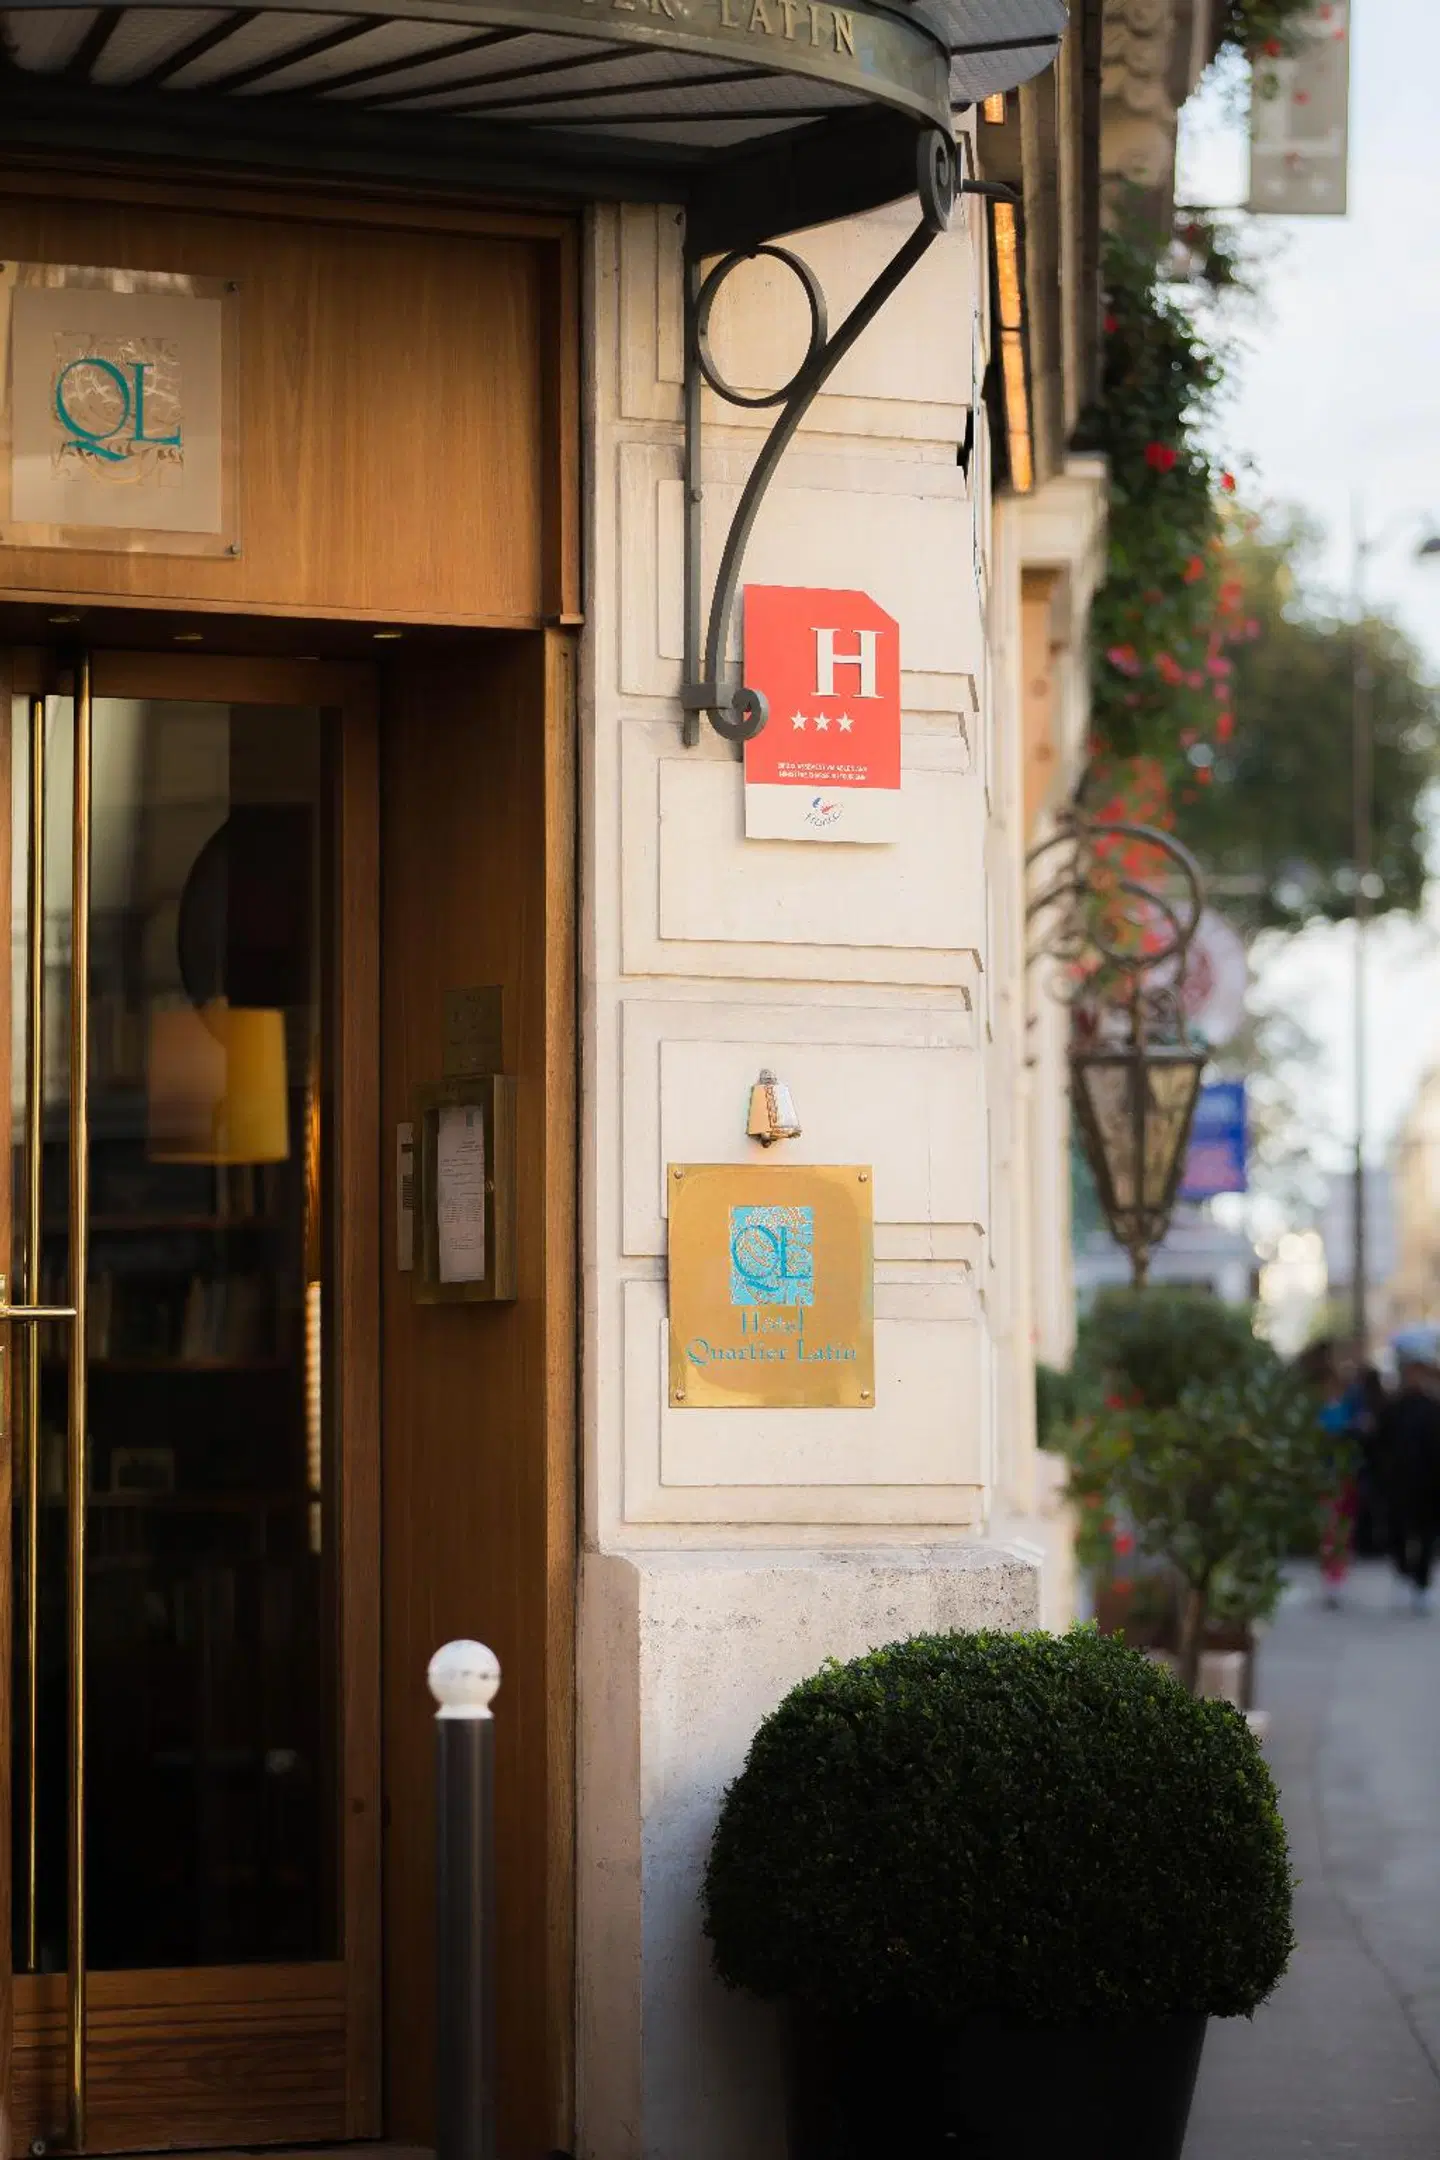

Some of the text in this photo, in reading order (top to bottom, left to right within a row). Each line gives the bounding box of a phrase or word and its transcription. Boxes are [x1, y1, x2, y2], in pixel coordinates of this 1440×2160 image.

[718, 0, 854, 55] LATIN
[56, 358, 182, 461] QL
[811, 628, 884, 698] H
[731, 1224, 813, 1291] QL
[687, 1337, 857, 1366] Quartier Latin
